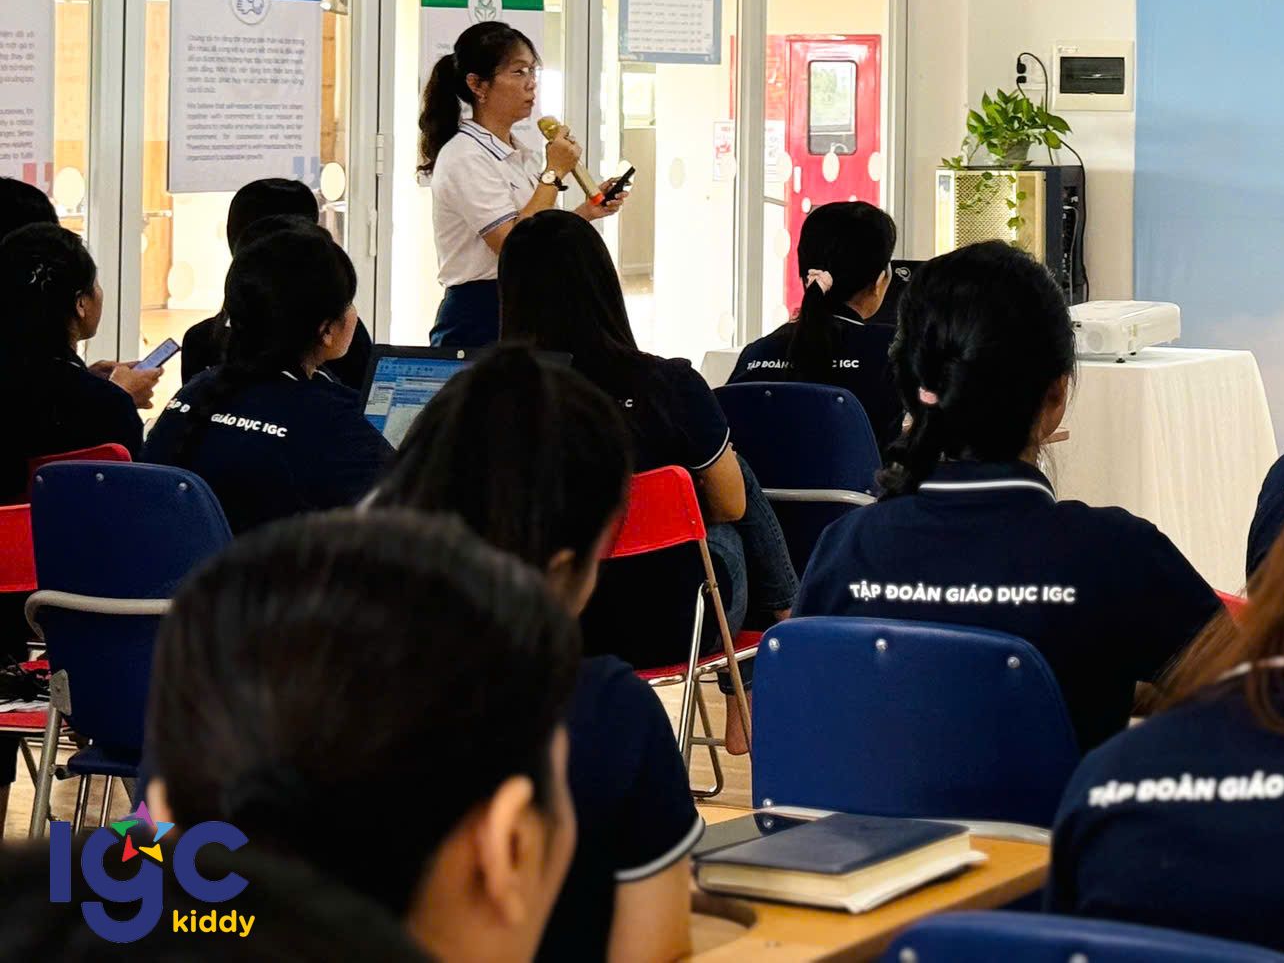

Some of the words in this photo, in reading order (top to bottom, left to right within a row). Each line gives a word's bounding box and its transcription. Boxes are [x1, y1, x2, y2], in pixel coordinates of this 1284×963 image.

[839, 359, 860, 369] IGC
[236, 417, 262, 431] DỤC
[262, 422, 288, 437] IGC
[849, 579, 881, 602] TẬP
[885, 582, 942, 602] ĐOÀN
[946, 584, 993, 603] GIÁO
[997, 585, 1039, 605] DỤC
[1042, 585, 1076, 603] IGC
[1136, 772, 1218, 803] ĐOÀN
